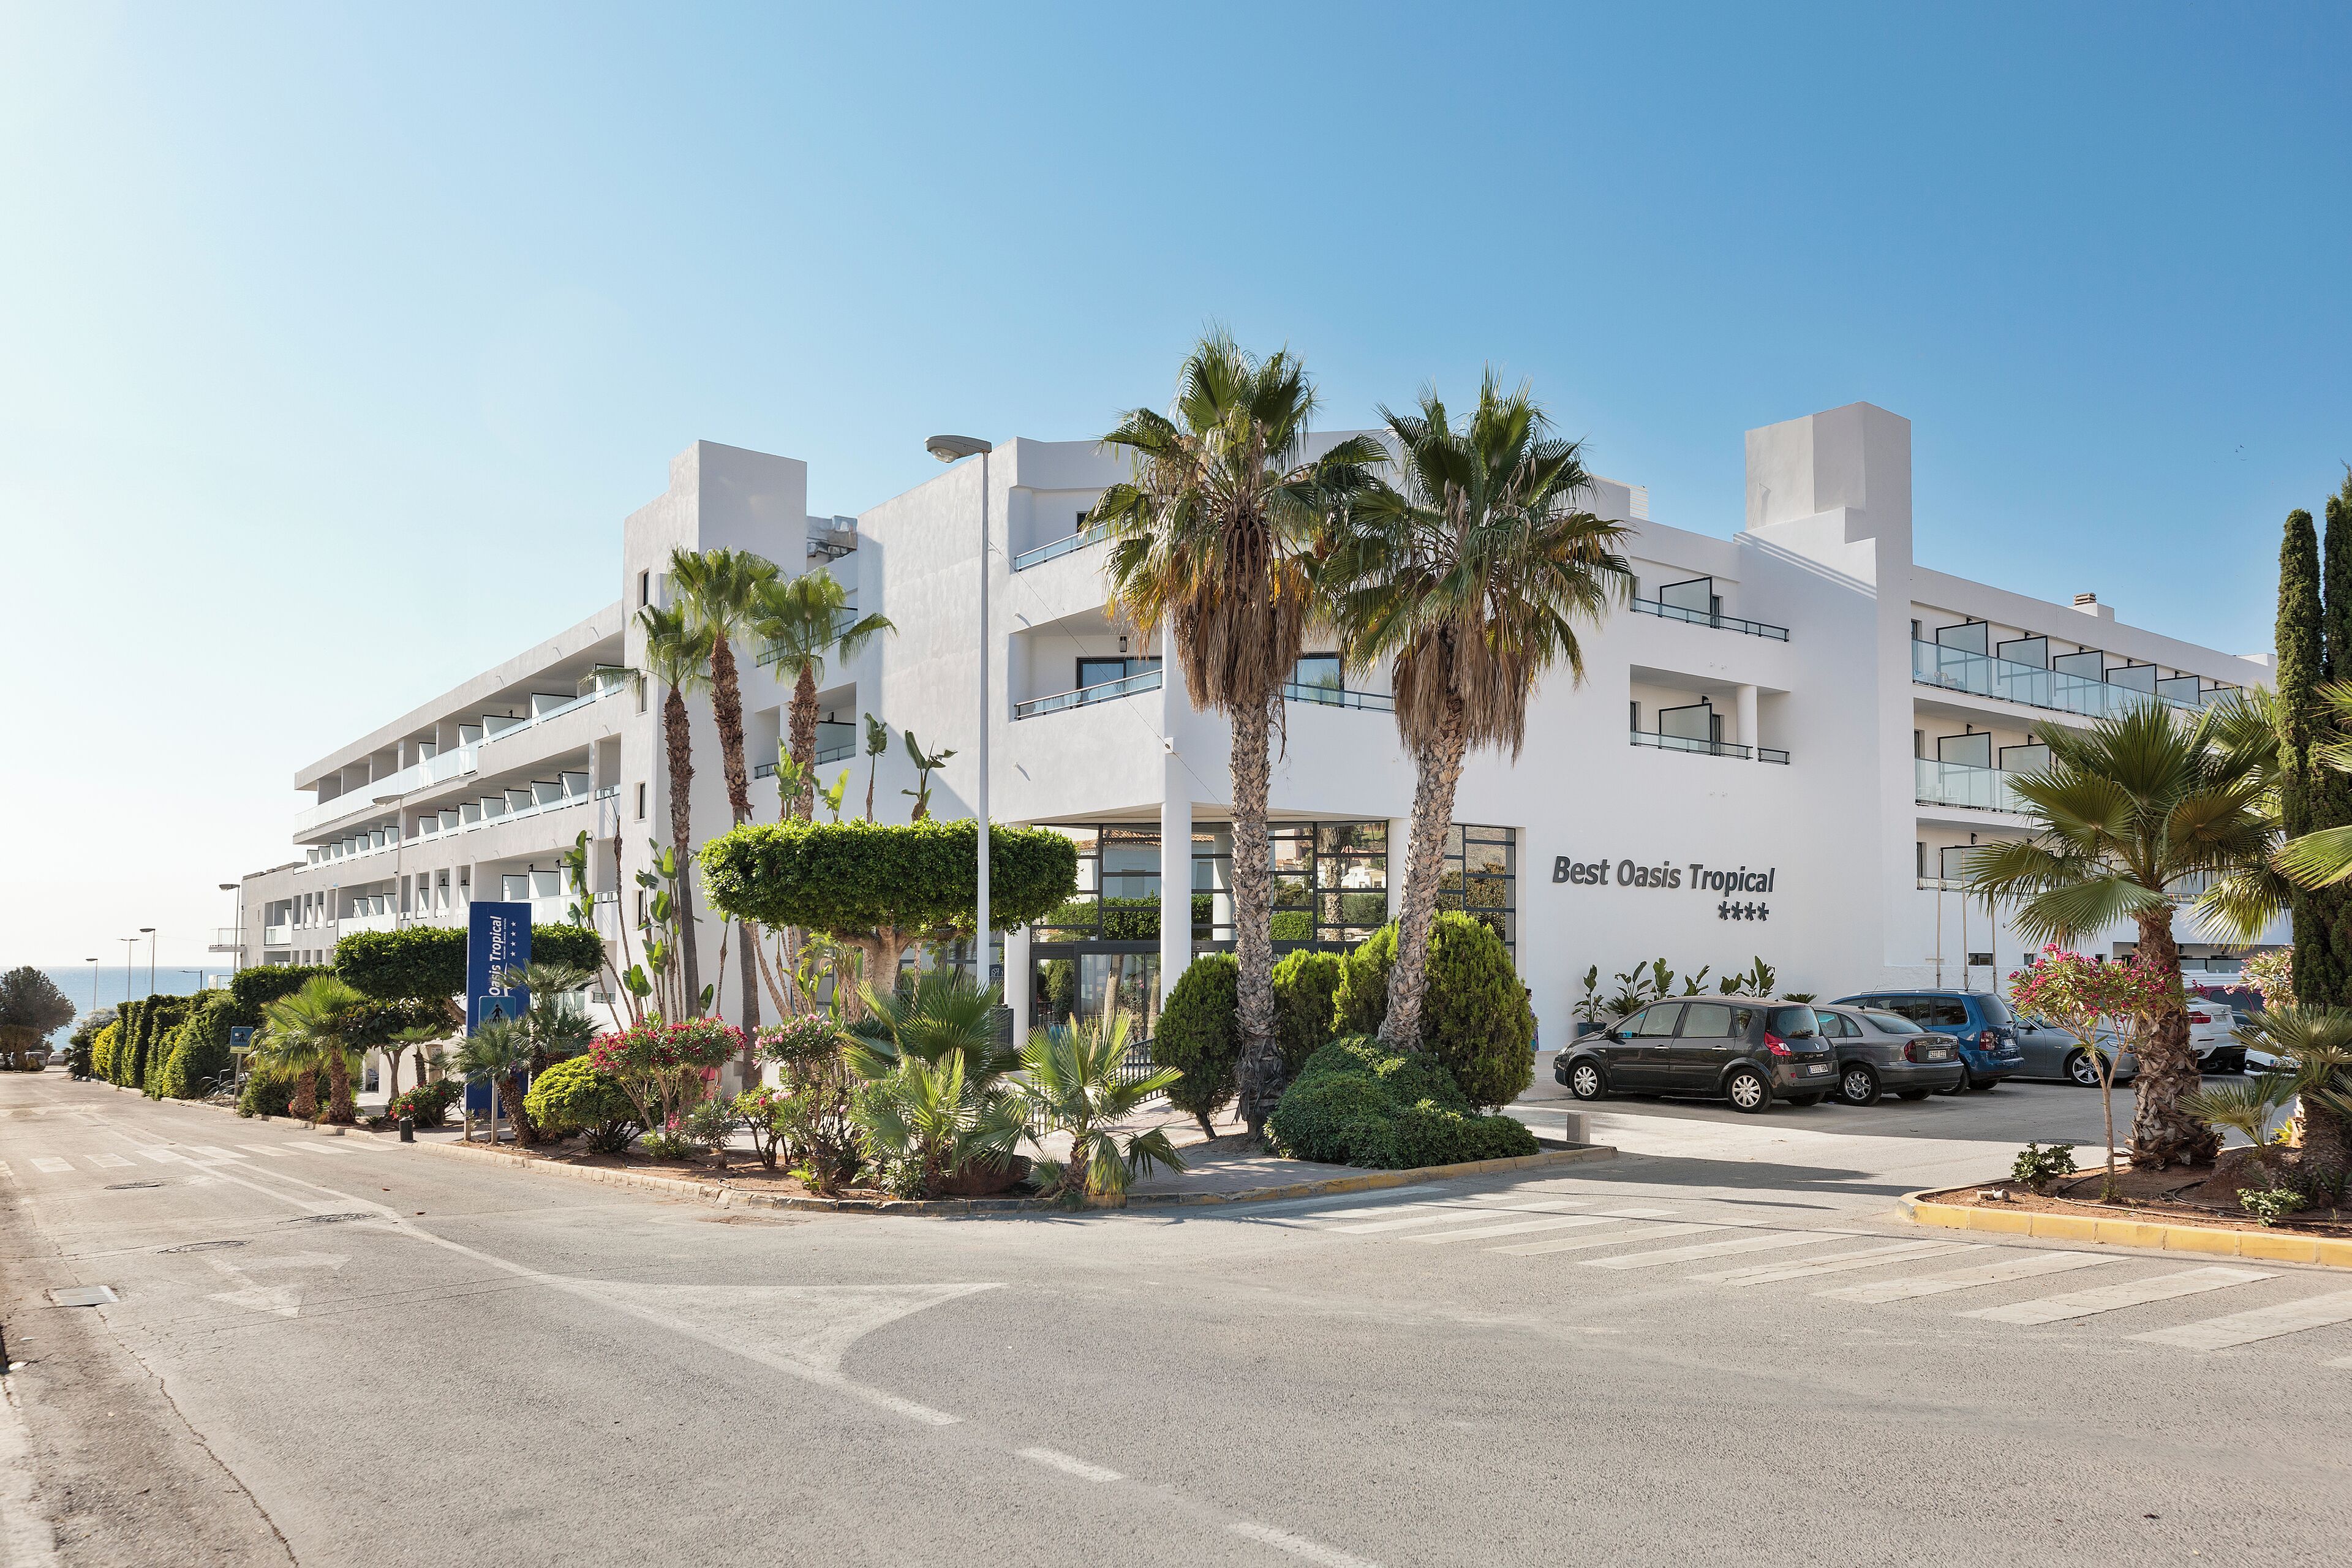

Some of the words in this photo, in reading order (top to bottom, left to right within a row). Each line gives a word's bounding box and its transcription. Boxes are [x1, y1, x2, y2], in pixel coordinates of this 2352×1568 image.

[1552, 856, 1610, 886] Best
[1617, 859, 1681, 889] Oasis
[1689, 864, 1776, 897] Tropical
[490, 916, 504, 962] Tropical
[489, 965, 502, 997] Oasis
